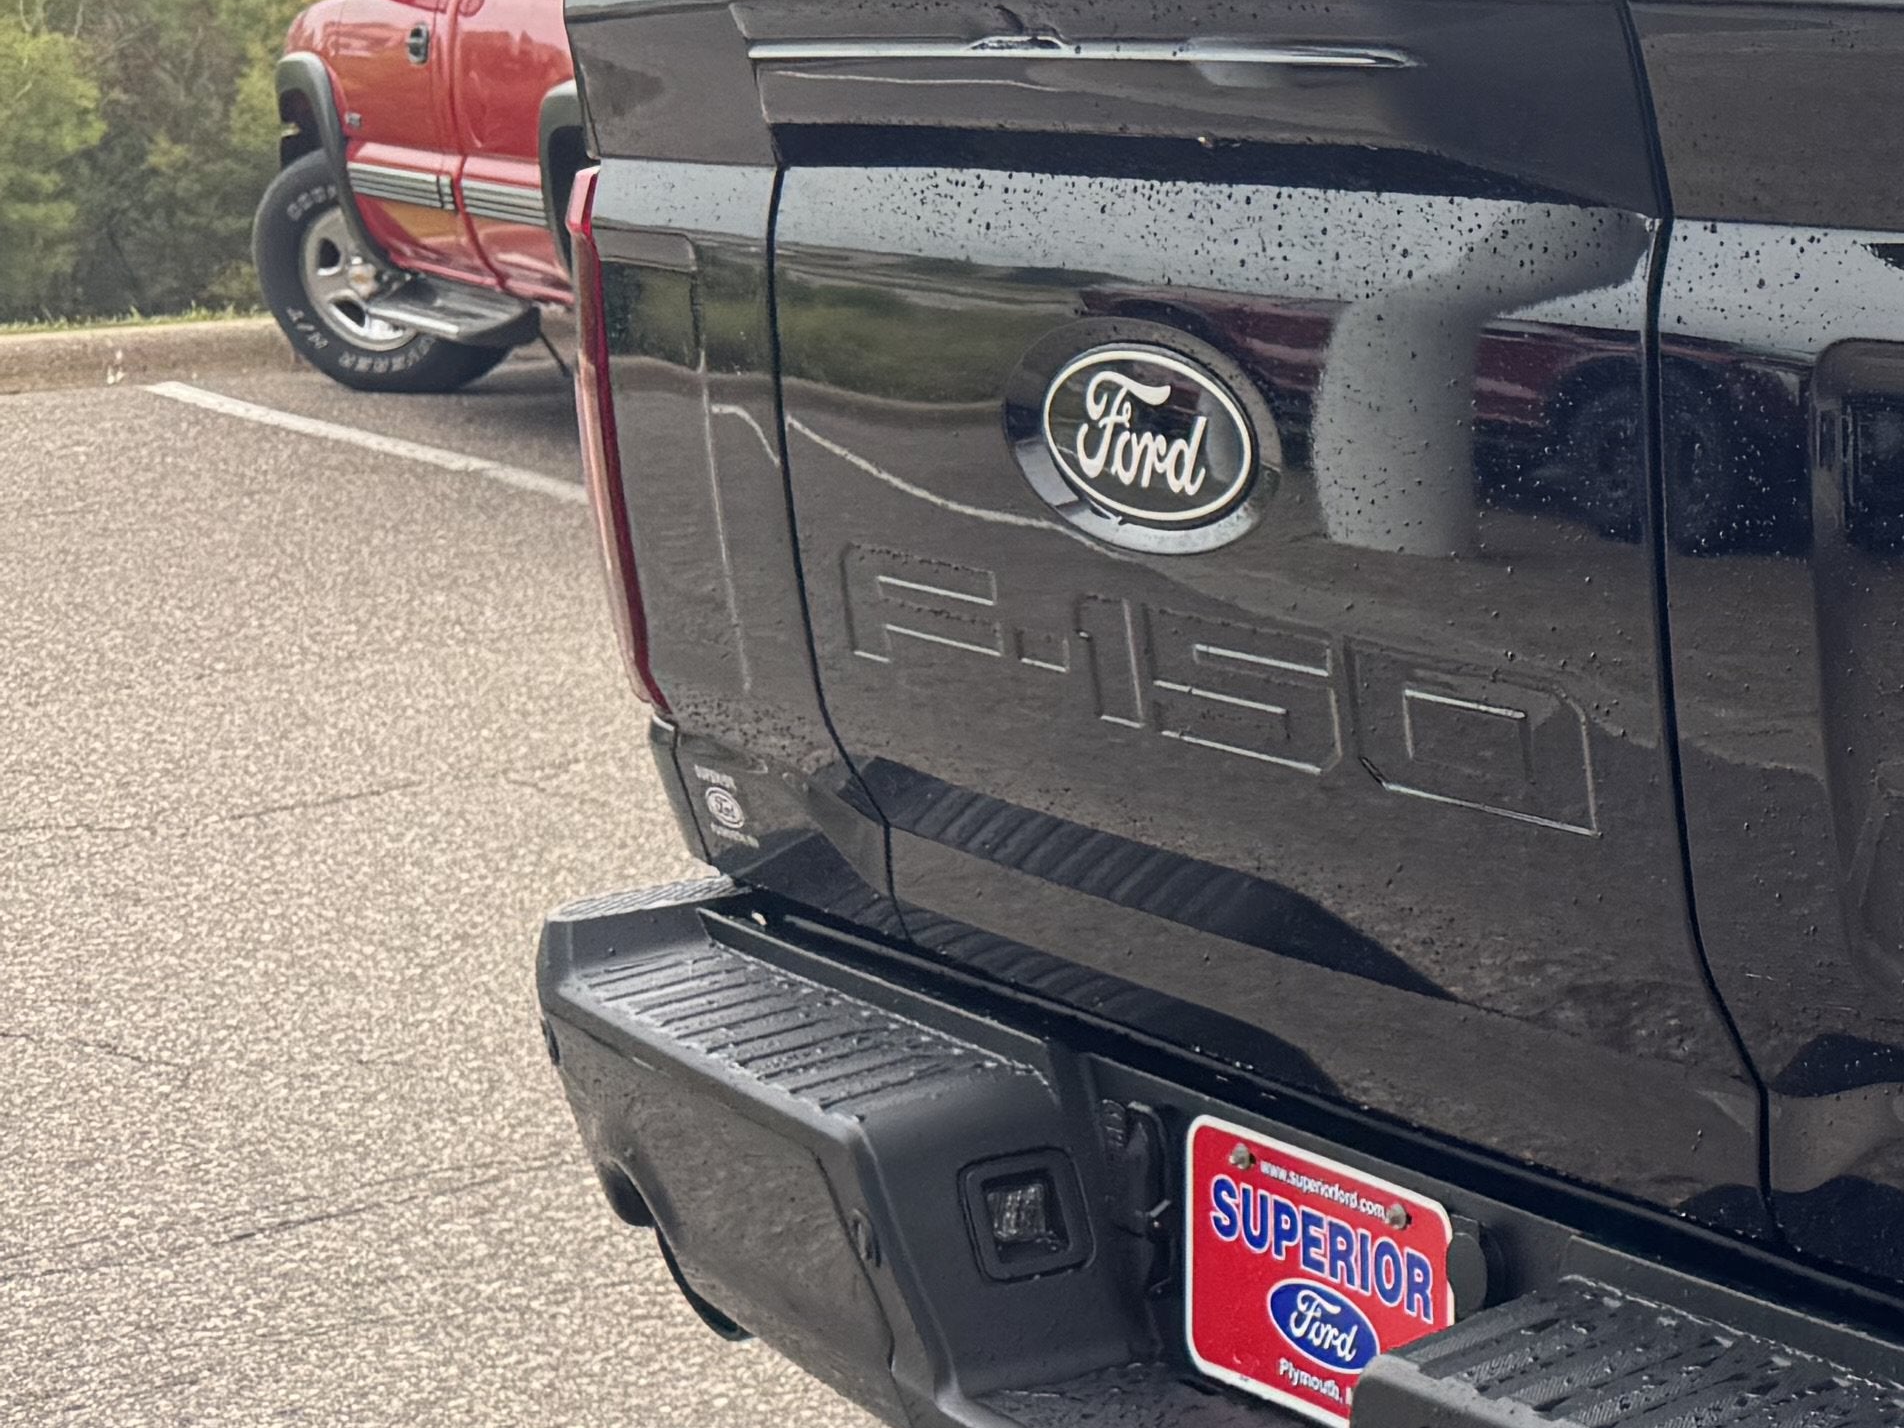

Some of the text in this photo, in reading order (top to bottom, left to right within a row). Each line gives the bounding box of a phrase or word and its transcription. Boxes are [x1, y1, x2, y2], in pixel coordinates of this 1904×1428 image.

[1076, 370, 1207, 496] Ford
[839, 541, 1600, 837] F-150
[1210, 1174, 1434, 1325] SUPERIOR
[1260, 1160, 1386, 1221] www.superiorford.com
[1289, 1289, 1358, 1362] Ford
